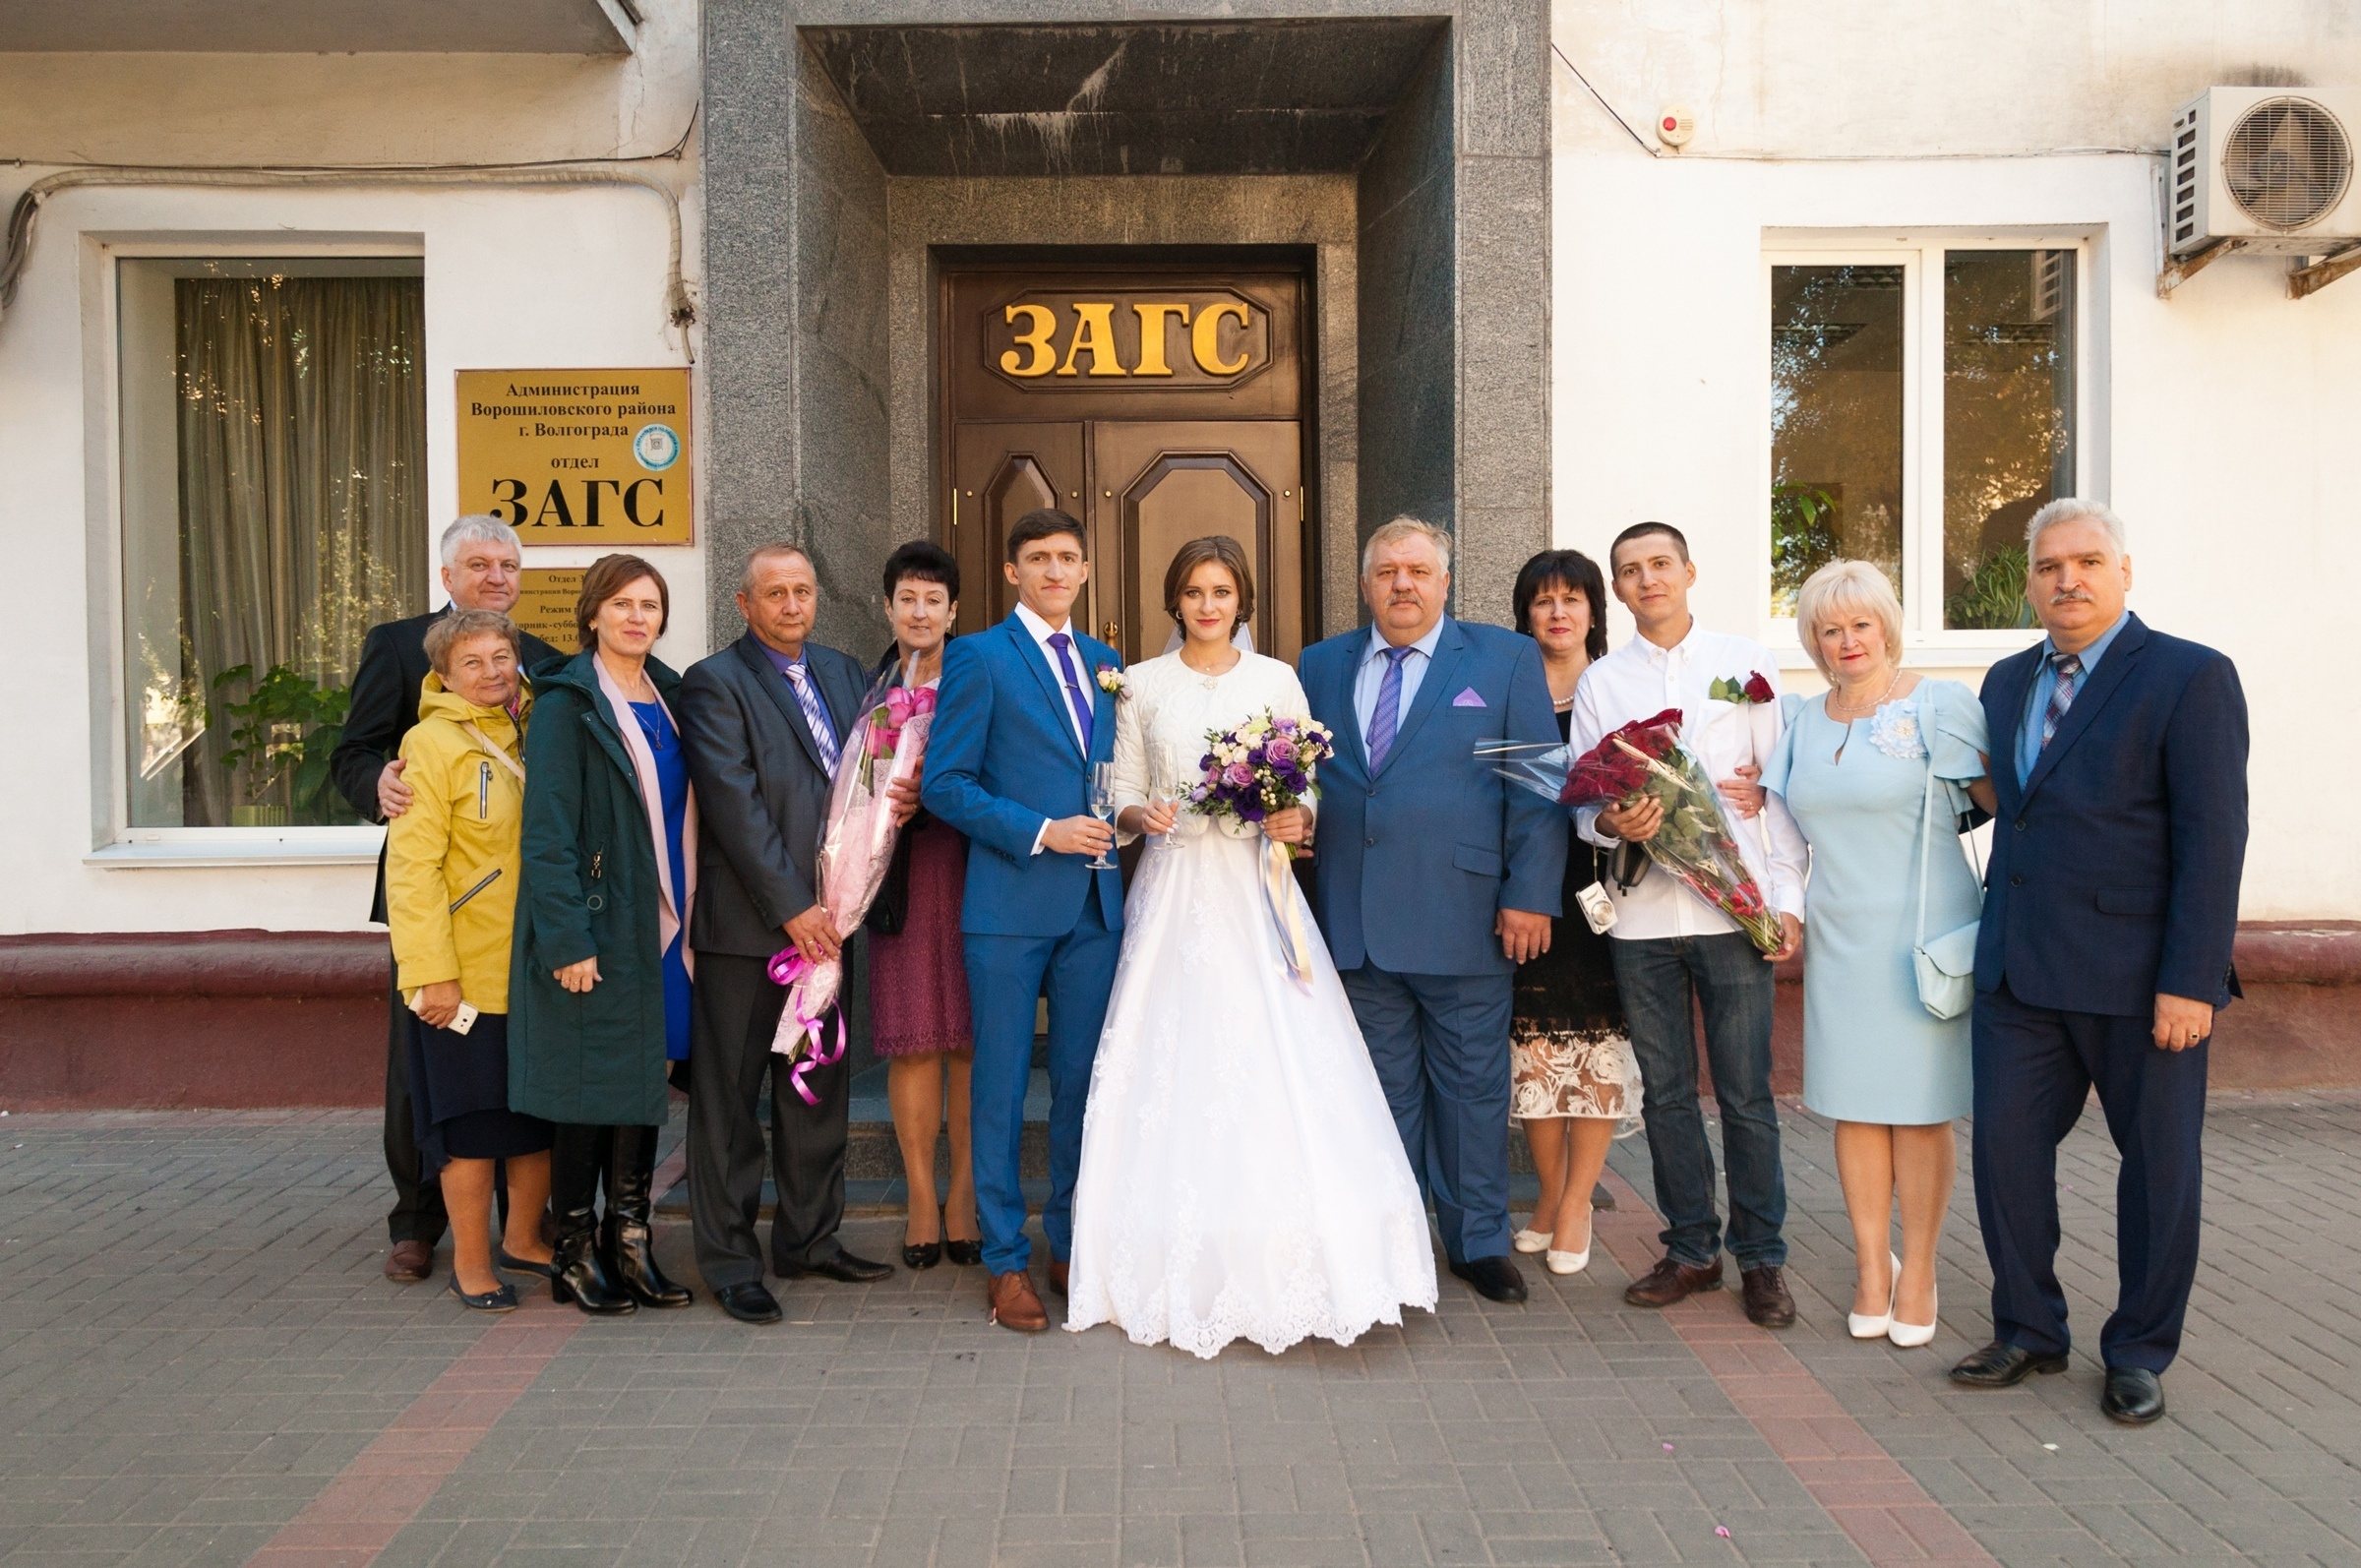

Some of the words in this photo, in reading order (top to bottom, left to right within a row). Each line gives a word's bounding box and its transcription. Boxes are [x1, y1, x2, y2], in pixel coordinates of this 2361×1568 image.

[999, 303, 1249, 378] ЗАГС
[506, 383, 640, 399] Администрация
[471, 402, 612, 419] Ворошиловского
[618, 401, 677, 418] района
[518, 425, 529, 437] г.
[534, 422, 629, 440] Волгограда
[551, 455, 600, 469] отдел
[490, 478, 664, 527] ЗАГС
[548, 574, 576, 583] Отдел
[539, 605, 572, 614] Режим
[539, 633, 558, 642] бед:
